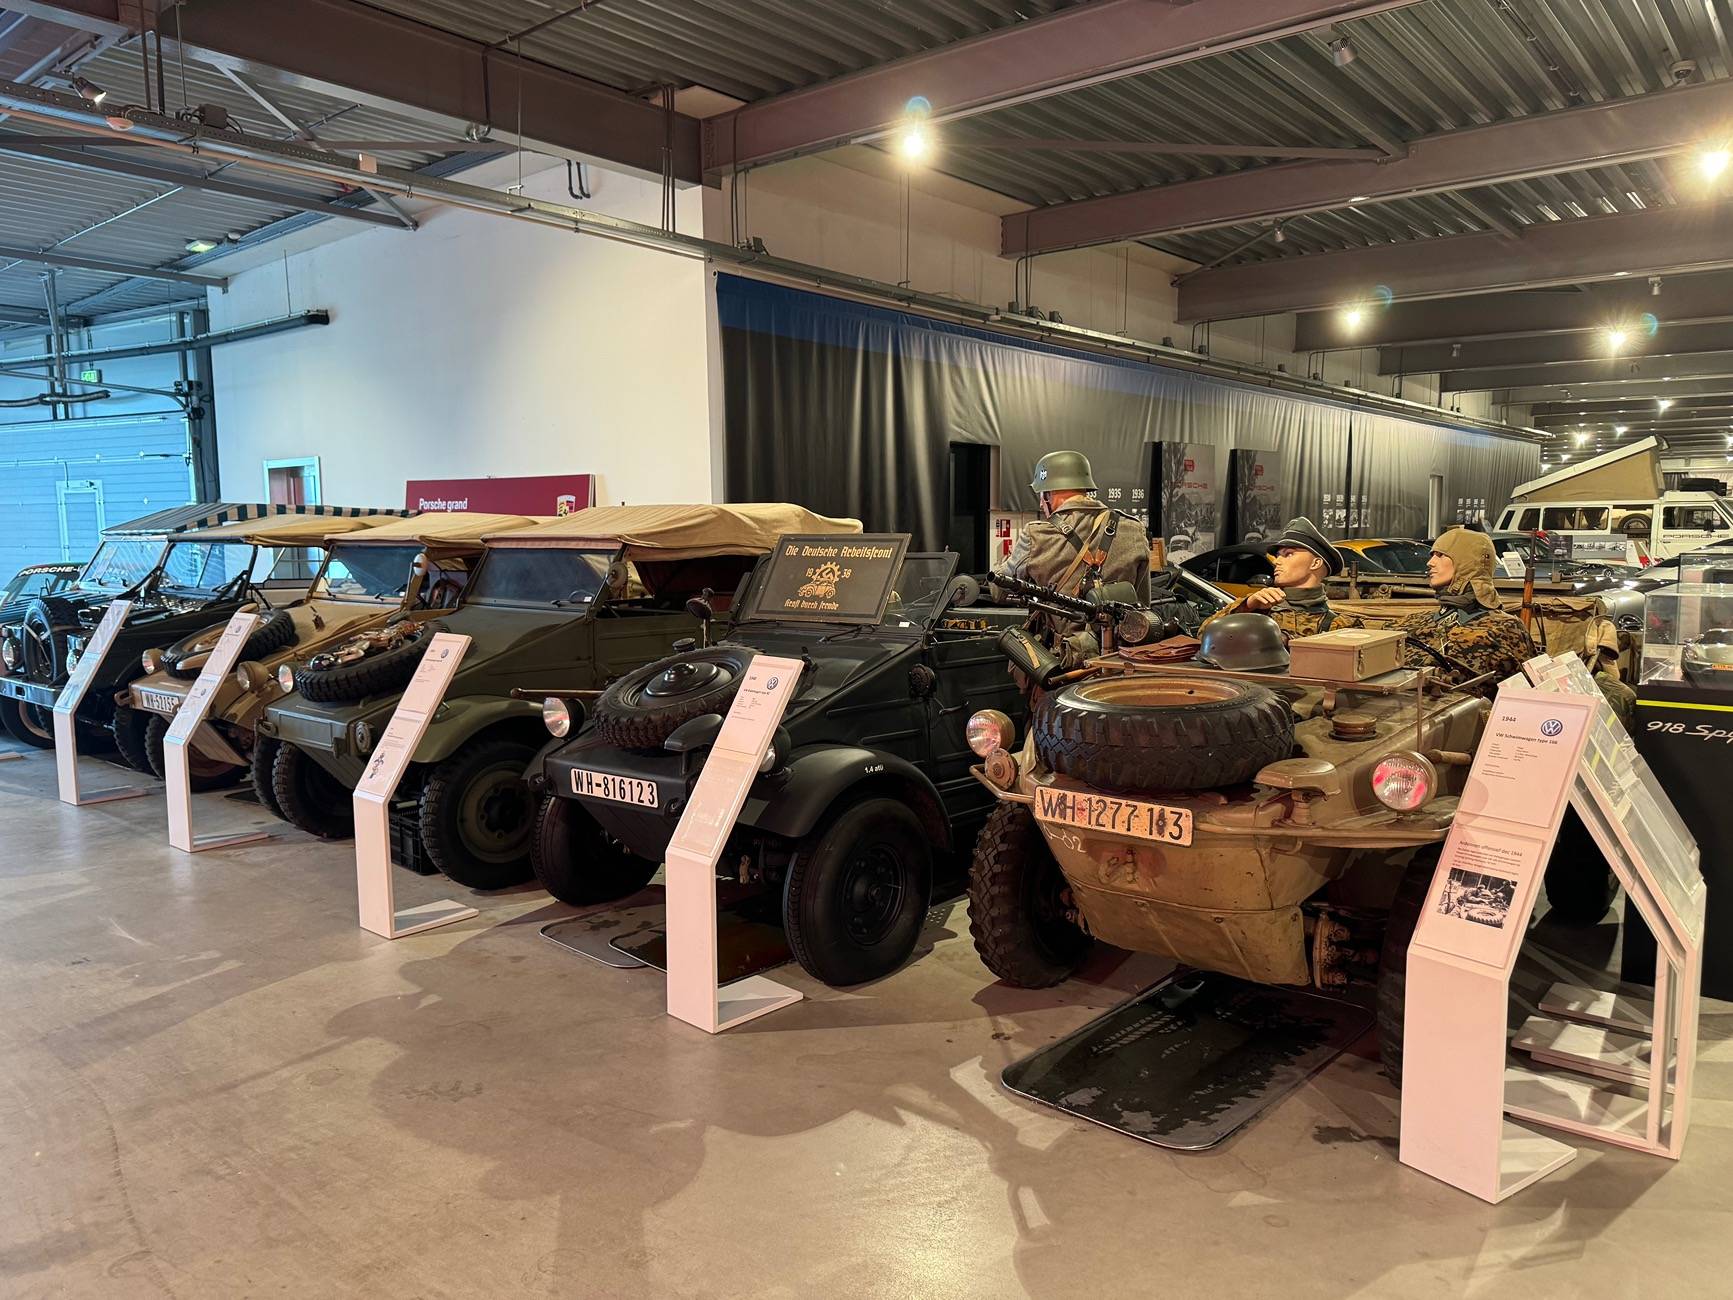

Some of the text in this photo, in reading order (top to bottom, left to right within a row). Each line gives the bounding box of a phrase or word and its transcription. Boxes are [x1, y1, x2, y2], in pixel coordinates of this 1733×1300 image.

[1108, 488, 1122, 499] 1935
[1131, 489, 1145, 499] 1936
[419, 498, 468, 512] Porsche grand
[785, 545, 799, 557] Die
[801, 545, 838, 558] Deutsche
[1647, 721, 1686, 734] 918
[573, 770, 656, 806] WH-816123
